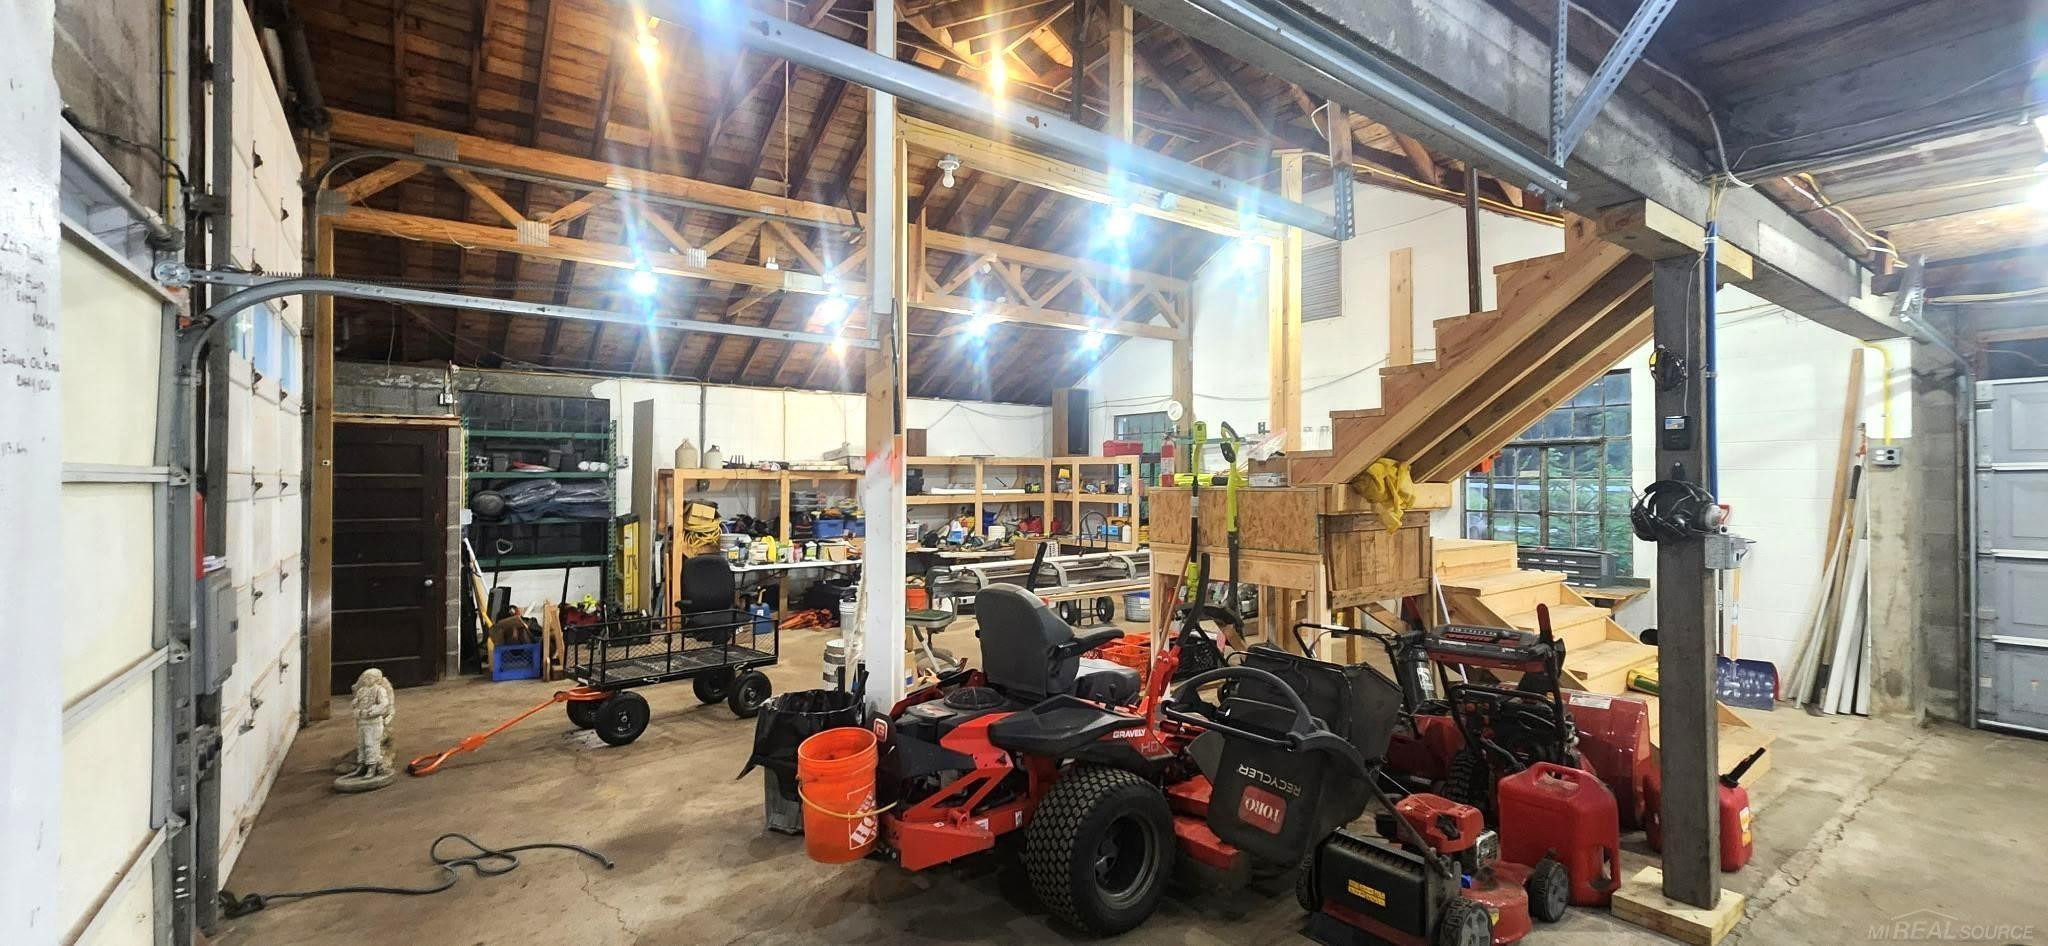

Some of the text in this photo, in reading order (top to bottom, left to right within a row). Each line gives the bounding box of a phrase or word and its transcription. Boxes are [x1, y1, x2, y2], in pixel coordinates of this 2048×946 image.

[1112, 728, 1146, 739] GRAVELY
[1238, 764, 1301, 797] RECYCLER
[1244, 797, 1281, 824] TORO
